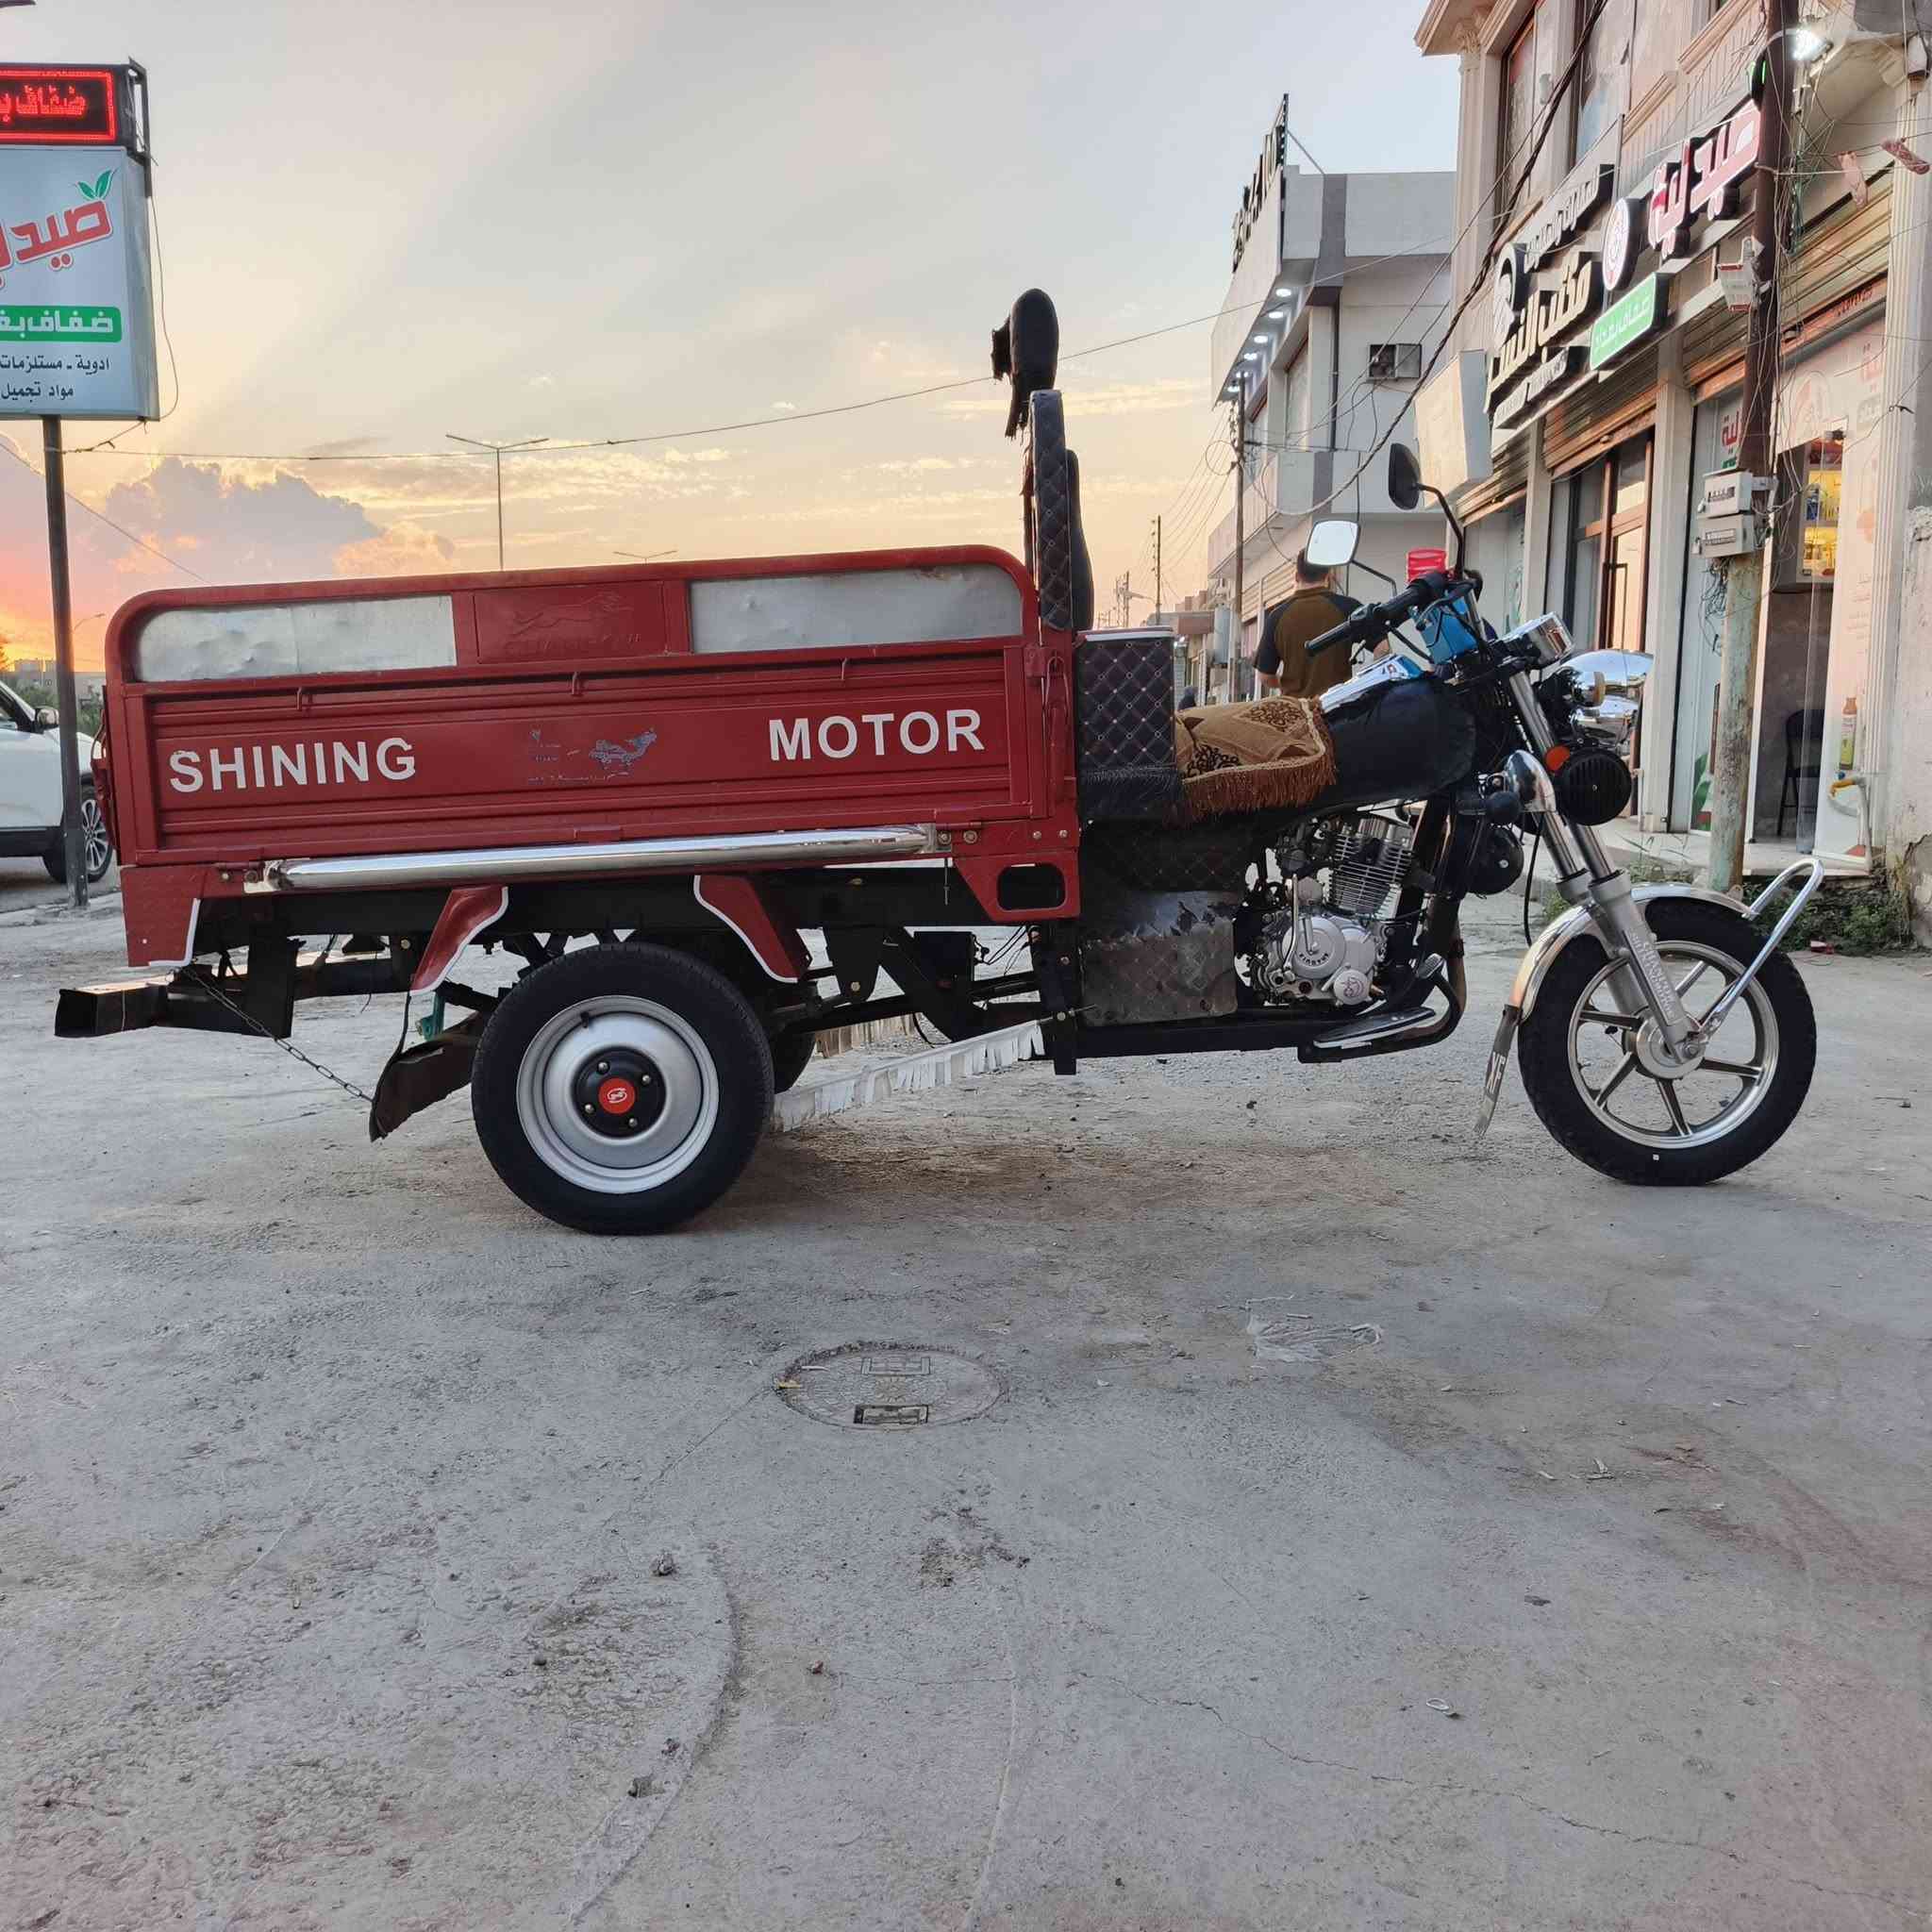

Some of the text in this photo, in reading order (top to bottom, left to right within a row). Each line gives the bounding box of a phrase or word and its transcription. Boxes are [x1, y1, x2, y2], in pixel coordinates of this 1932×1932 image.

[1647, 99, 1761, 260] صيدلية
[26, 309, 114, 332] ضفاف
[1537, 250, 1592, 364] مكتب
[1, 382, 74, 403] مواد تجميل
[769, 708, 985, 761] MOTOR
[169, 737, 416, 792] SHINING
